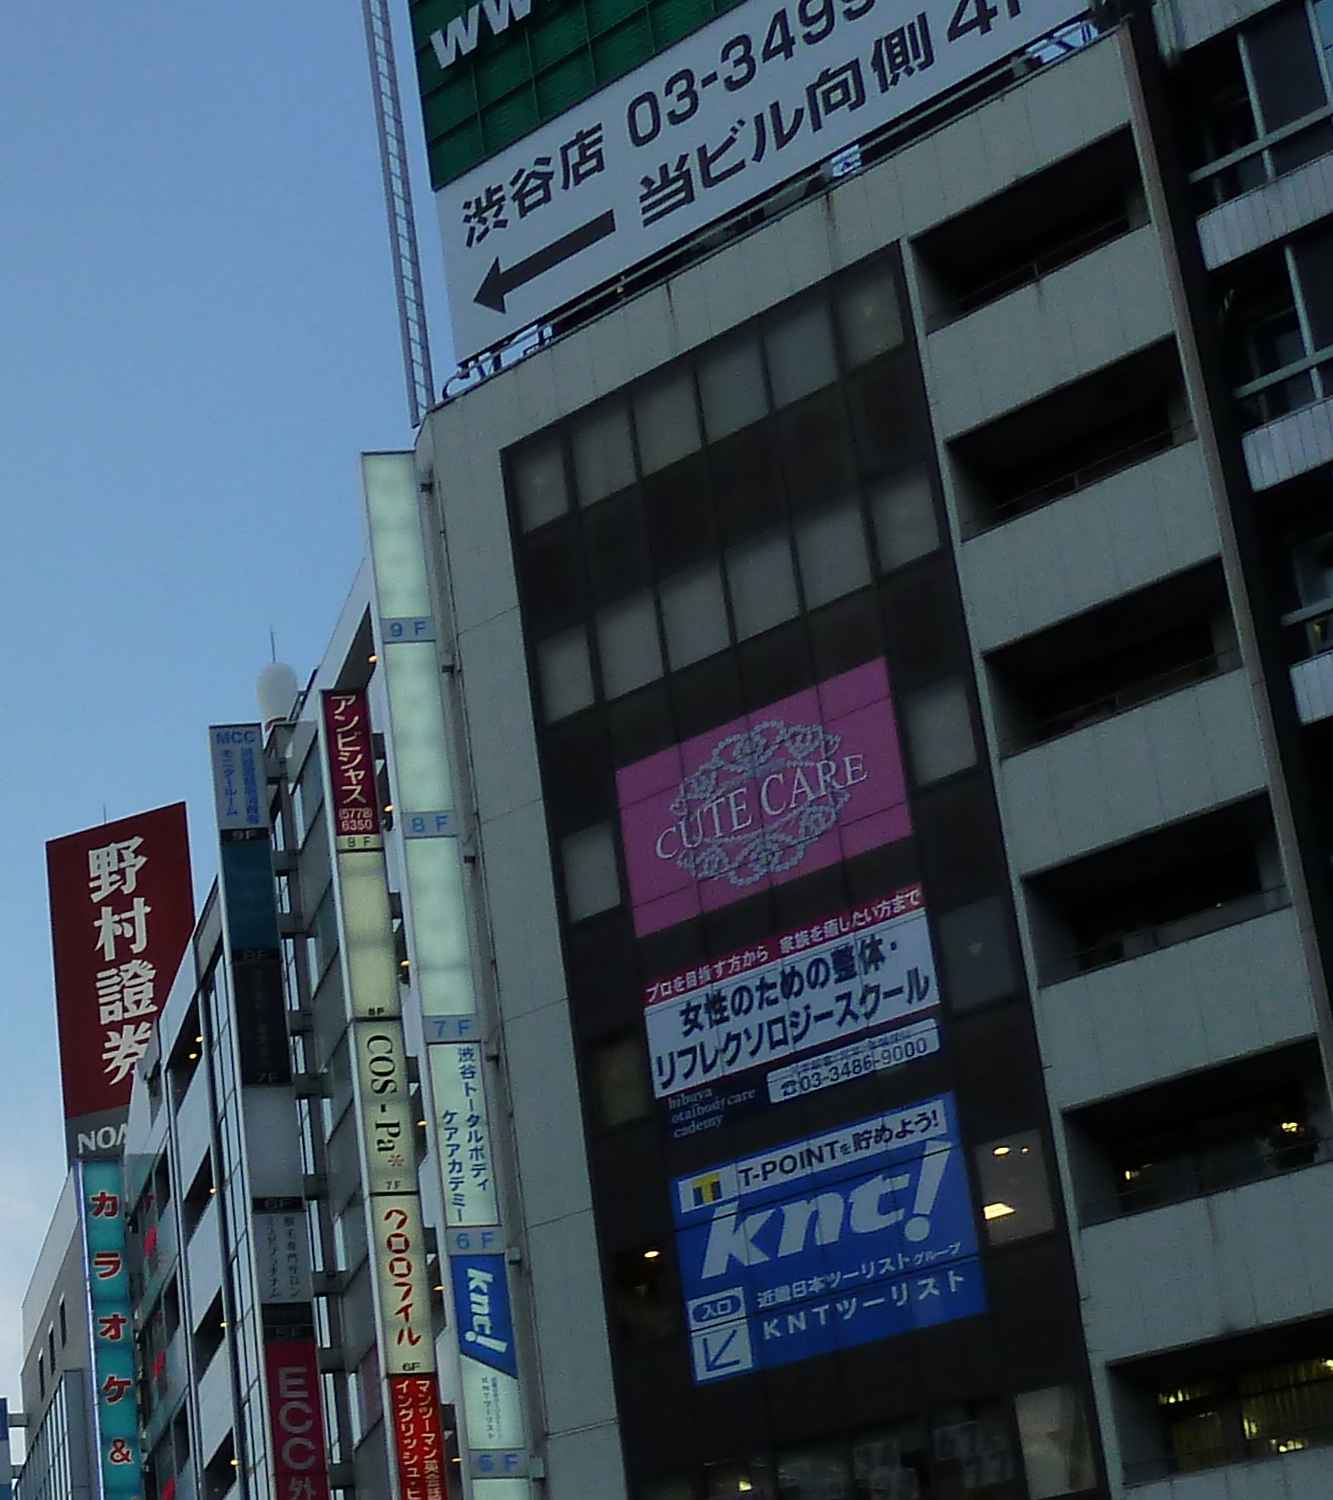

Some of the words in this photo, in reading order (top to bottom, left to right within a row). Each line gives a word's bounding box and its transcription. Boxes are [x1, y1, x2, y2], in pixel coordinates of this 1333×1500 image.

[461, 123, 605, 247] 渋谷店
[216, 731, 255, 744] MCC
[329, 693, 366, 805] アンビシャス
[339, 806, 374, 822] (5778)
[341, 818, 374, 833] 6350
[655, 781, 754, 861] CUTE
[760, 752, 870, 823] CARE
[88, 836, 158, 1086] 野村證券
[646, 945, 769, 1002] プロを目指す方から
[657, 967, 929, 1089] リフレクソロジースクール
[800, 1038, 926, 1091] 03-3486-9000
[443, 1110, 465, 1222] ケアアカデミー
[457, 1047, 490, 1192] 渋谷トータルボディ
[457, 1233, 495, 1249] 6F
[701, 1140, 953, 1279] knt!
[465, 1268, 508, 1353] knt!
[402, 1363, 421, 1371] 6F
